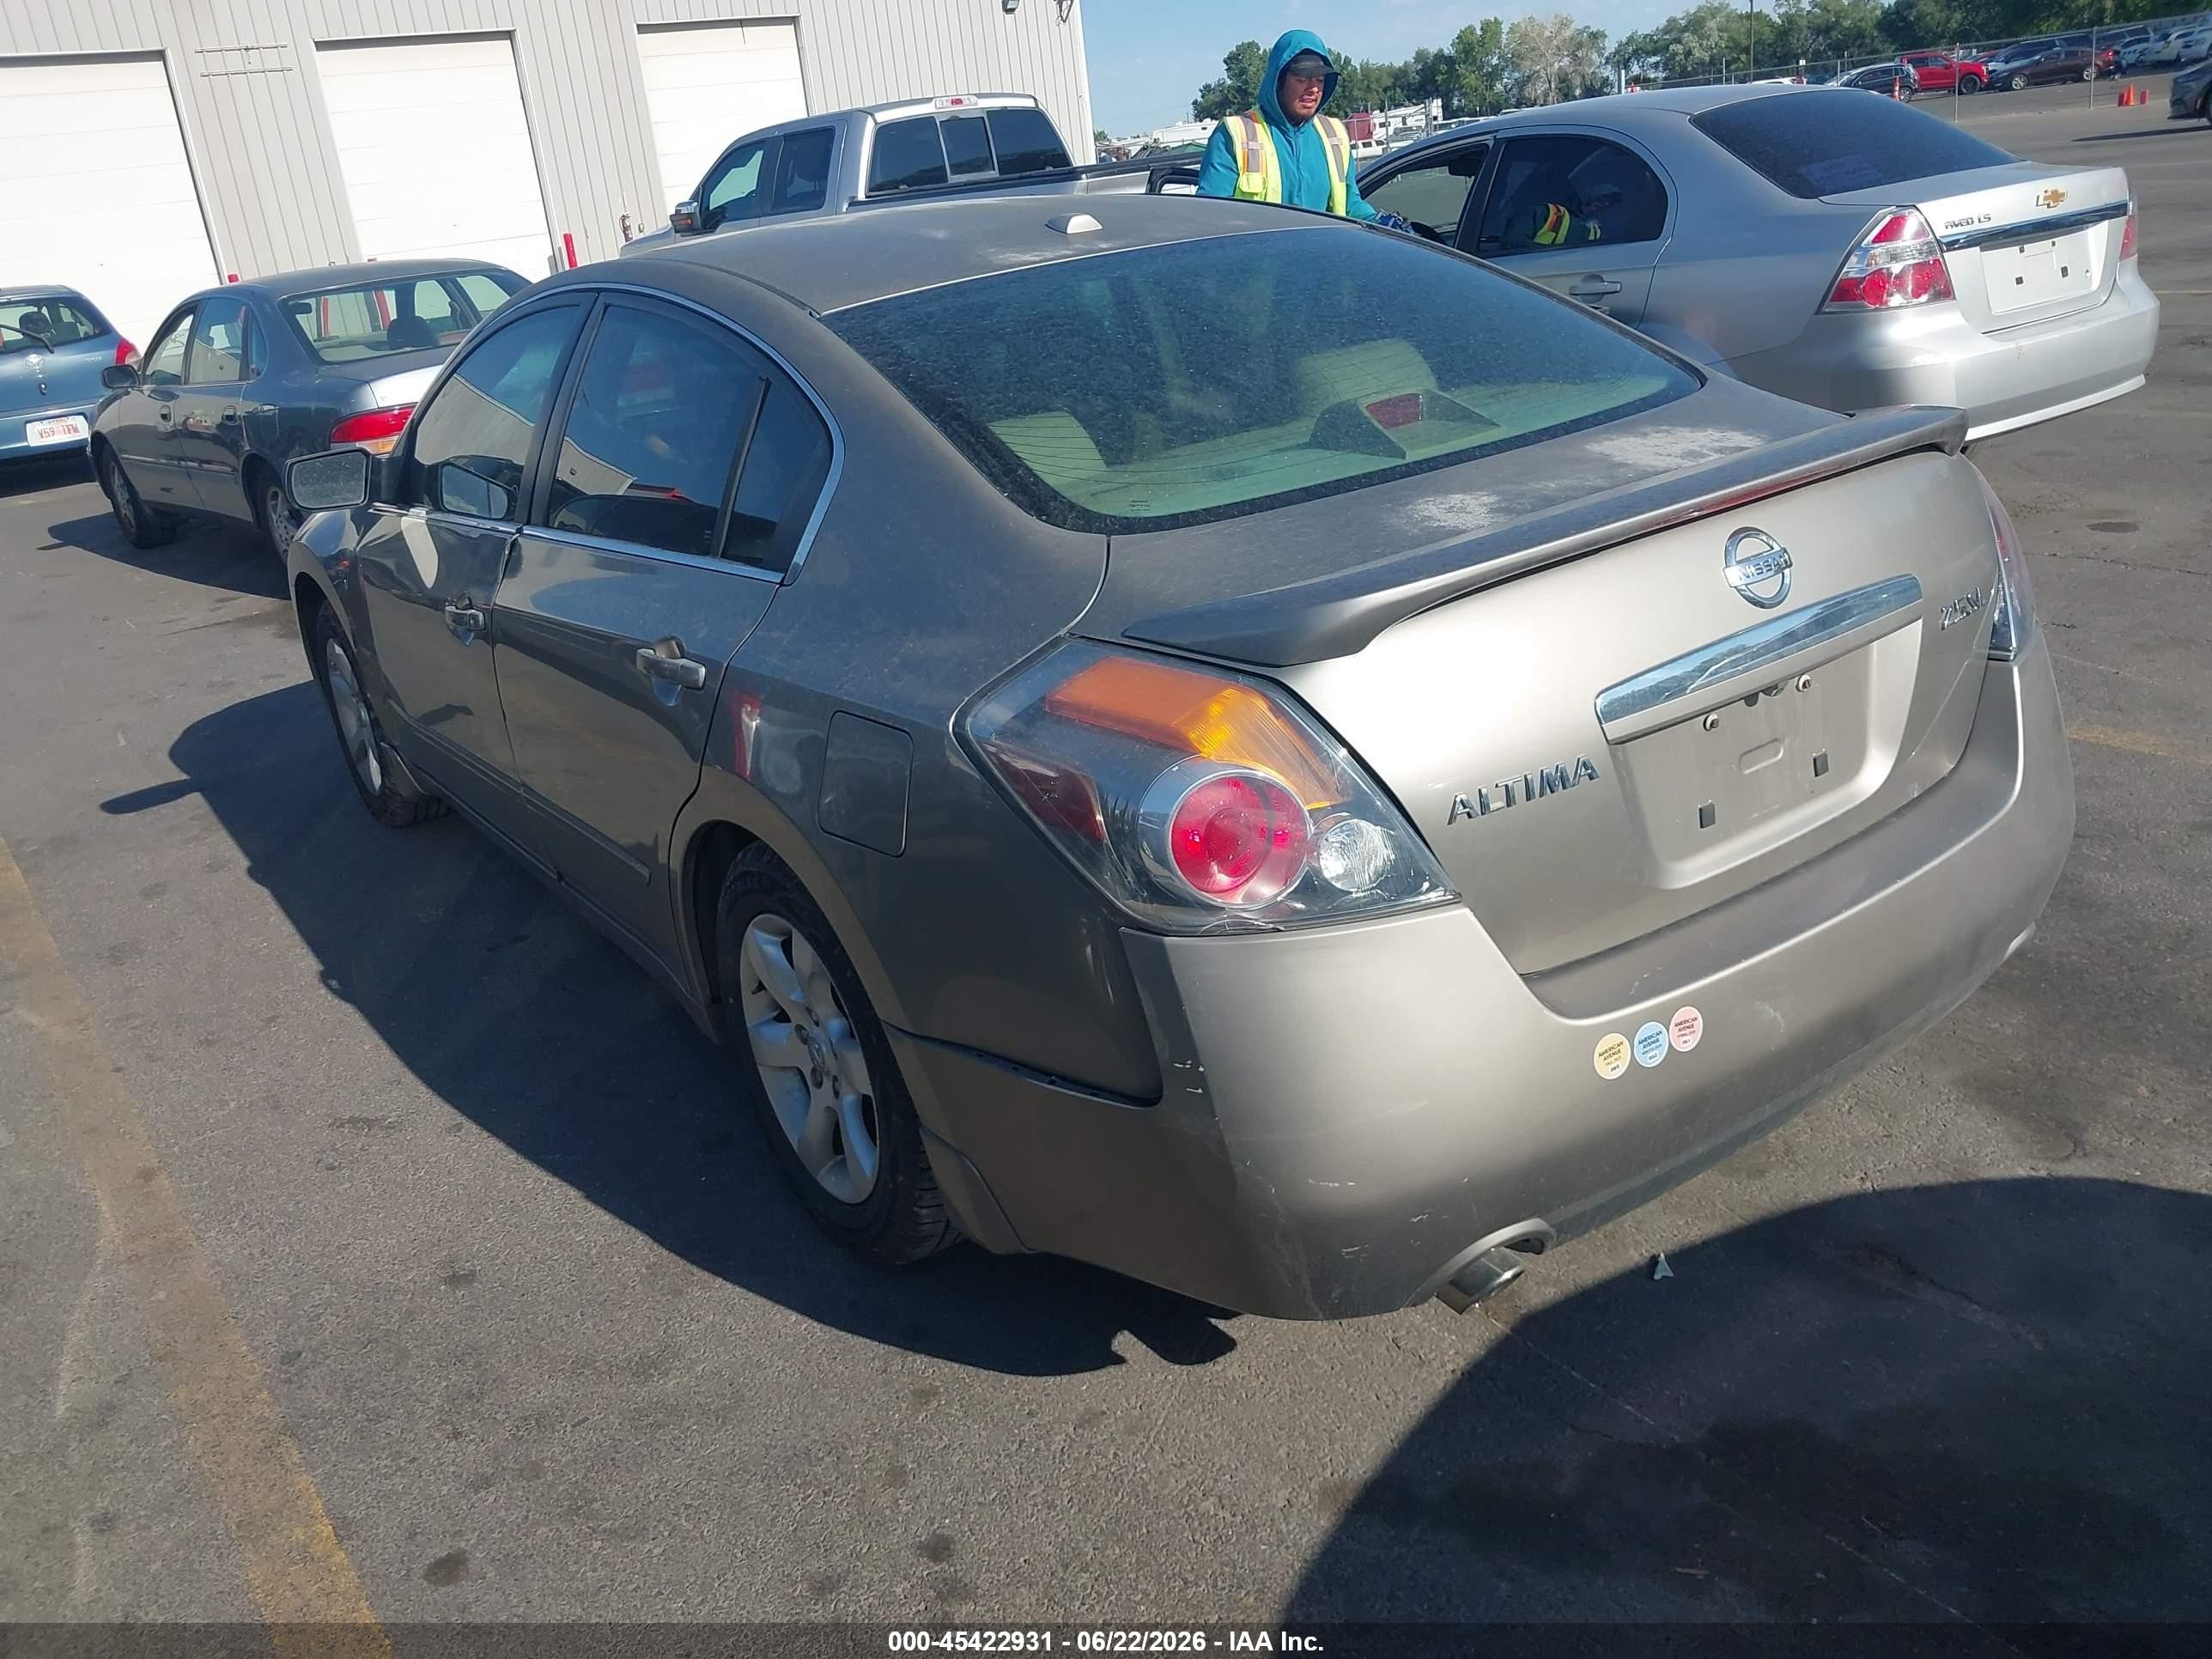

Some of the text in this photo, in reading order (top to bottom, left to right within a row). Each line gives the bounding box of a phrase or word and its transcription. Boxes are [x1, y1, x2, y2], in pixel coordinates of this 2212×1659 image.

[1978, 213, 1992, 224] LS
[1738, 551, 1790, 581] NISSAN
[1447, 755, 1601, 826] ALTIMA
[1674, 1016, 1698, 1029] AMERICAN
[1677, 1023, 1696, 1033] AVENUE
[1637, 1030, 1663, 1046] AMERICAN
[1641, 1037, 1662, 1050] AVENUE
[1597, 1040, 1625, 1059] AMERICAN
[1602, 1048, 1622, 1062] AVENUE
